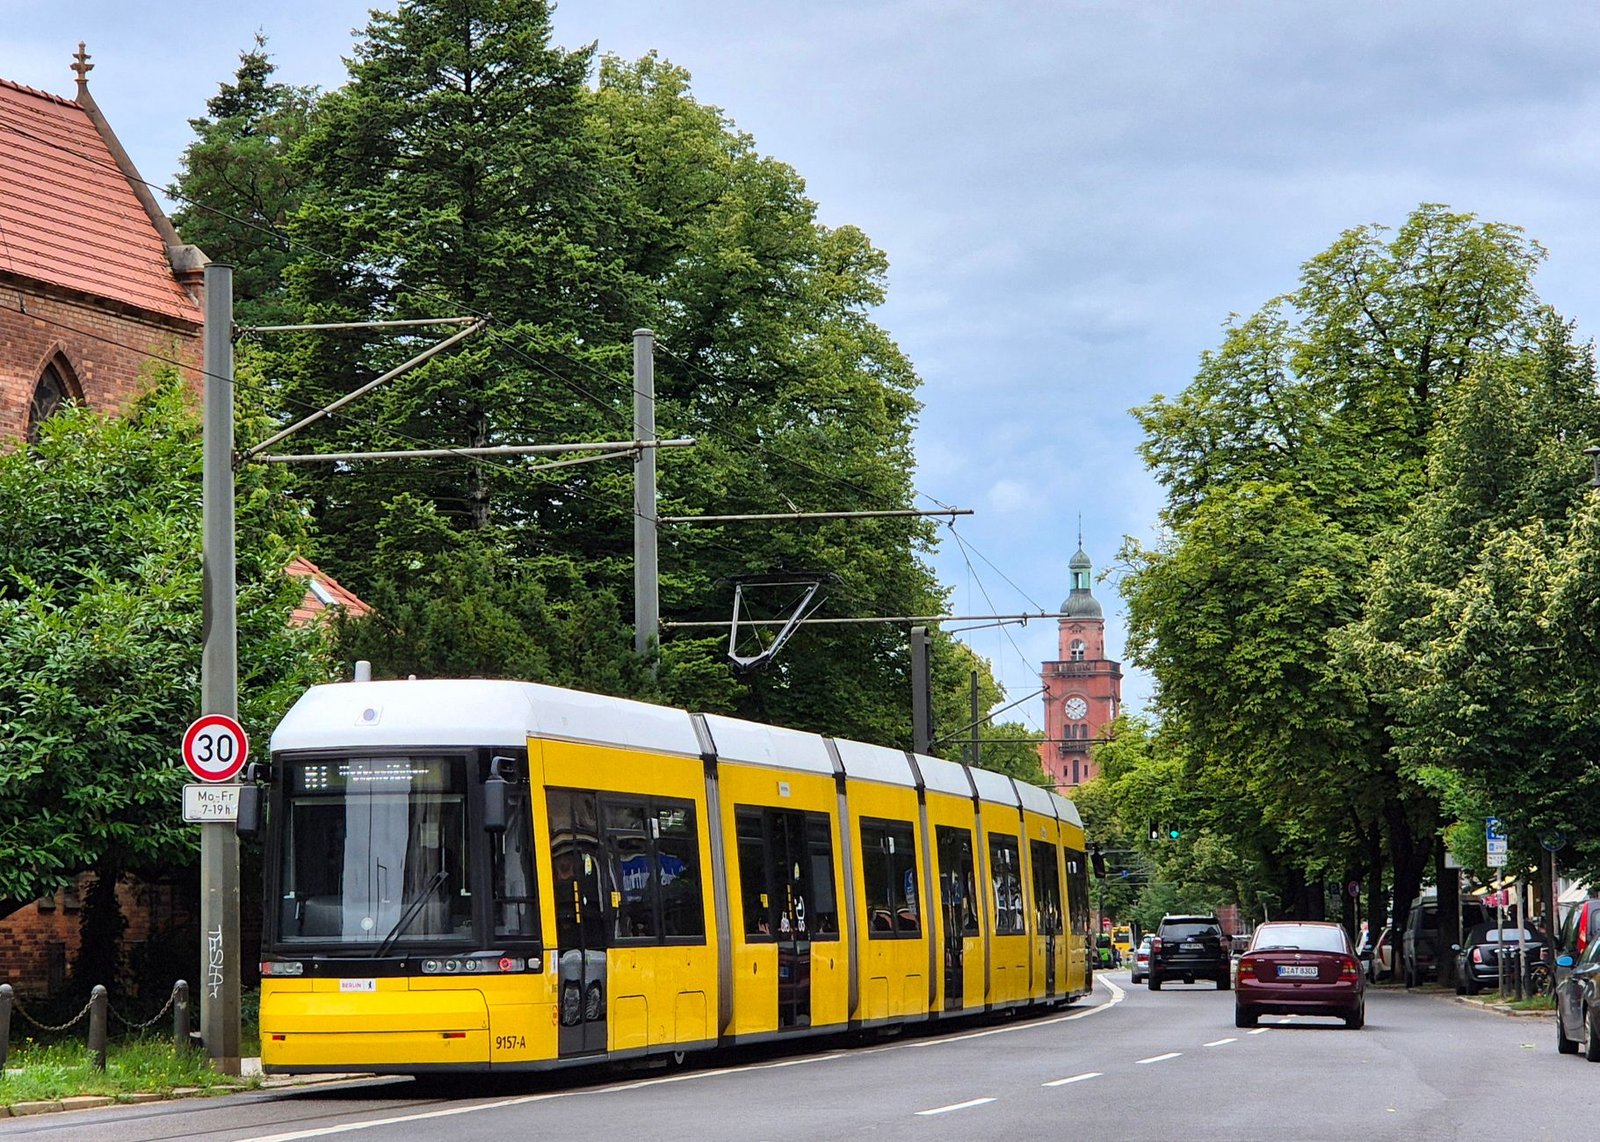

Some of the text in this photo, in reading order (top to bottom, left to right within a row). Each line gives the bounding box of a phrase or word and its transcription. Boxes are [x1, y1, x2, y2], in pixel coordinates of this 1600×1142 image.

[198, 734, 232, 762] 30
[198, 791, 233, 801] Mo-Fr
[495, 1035, 526, 1050] 9157-A
